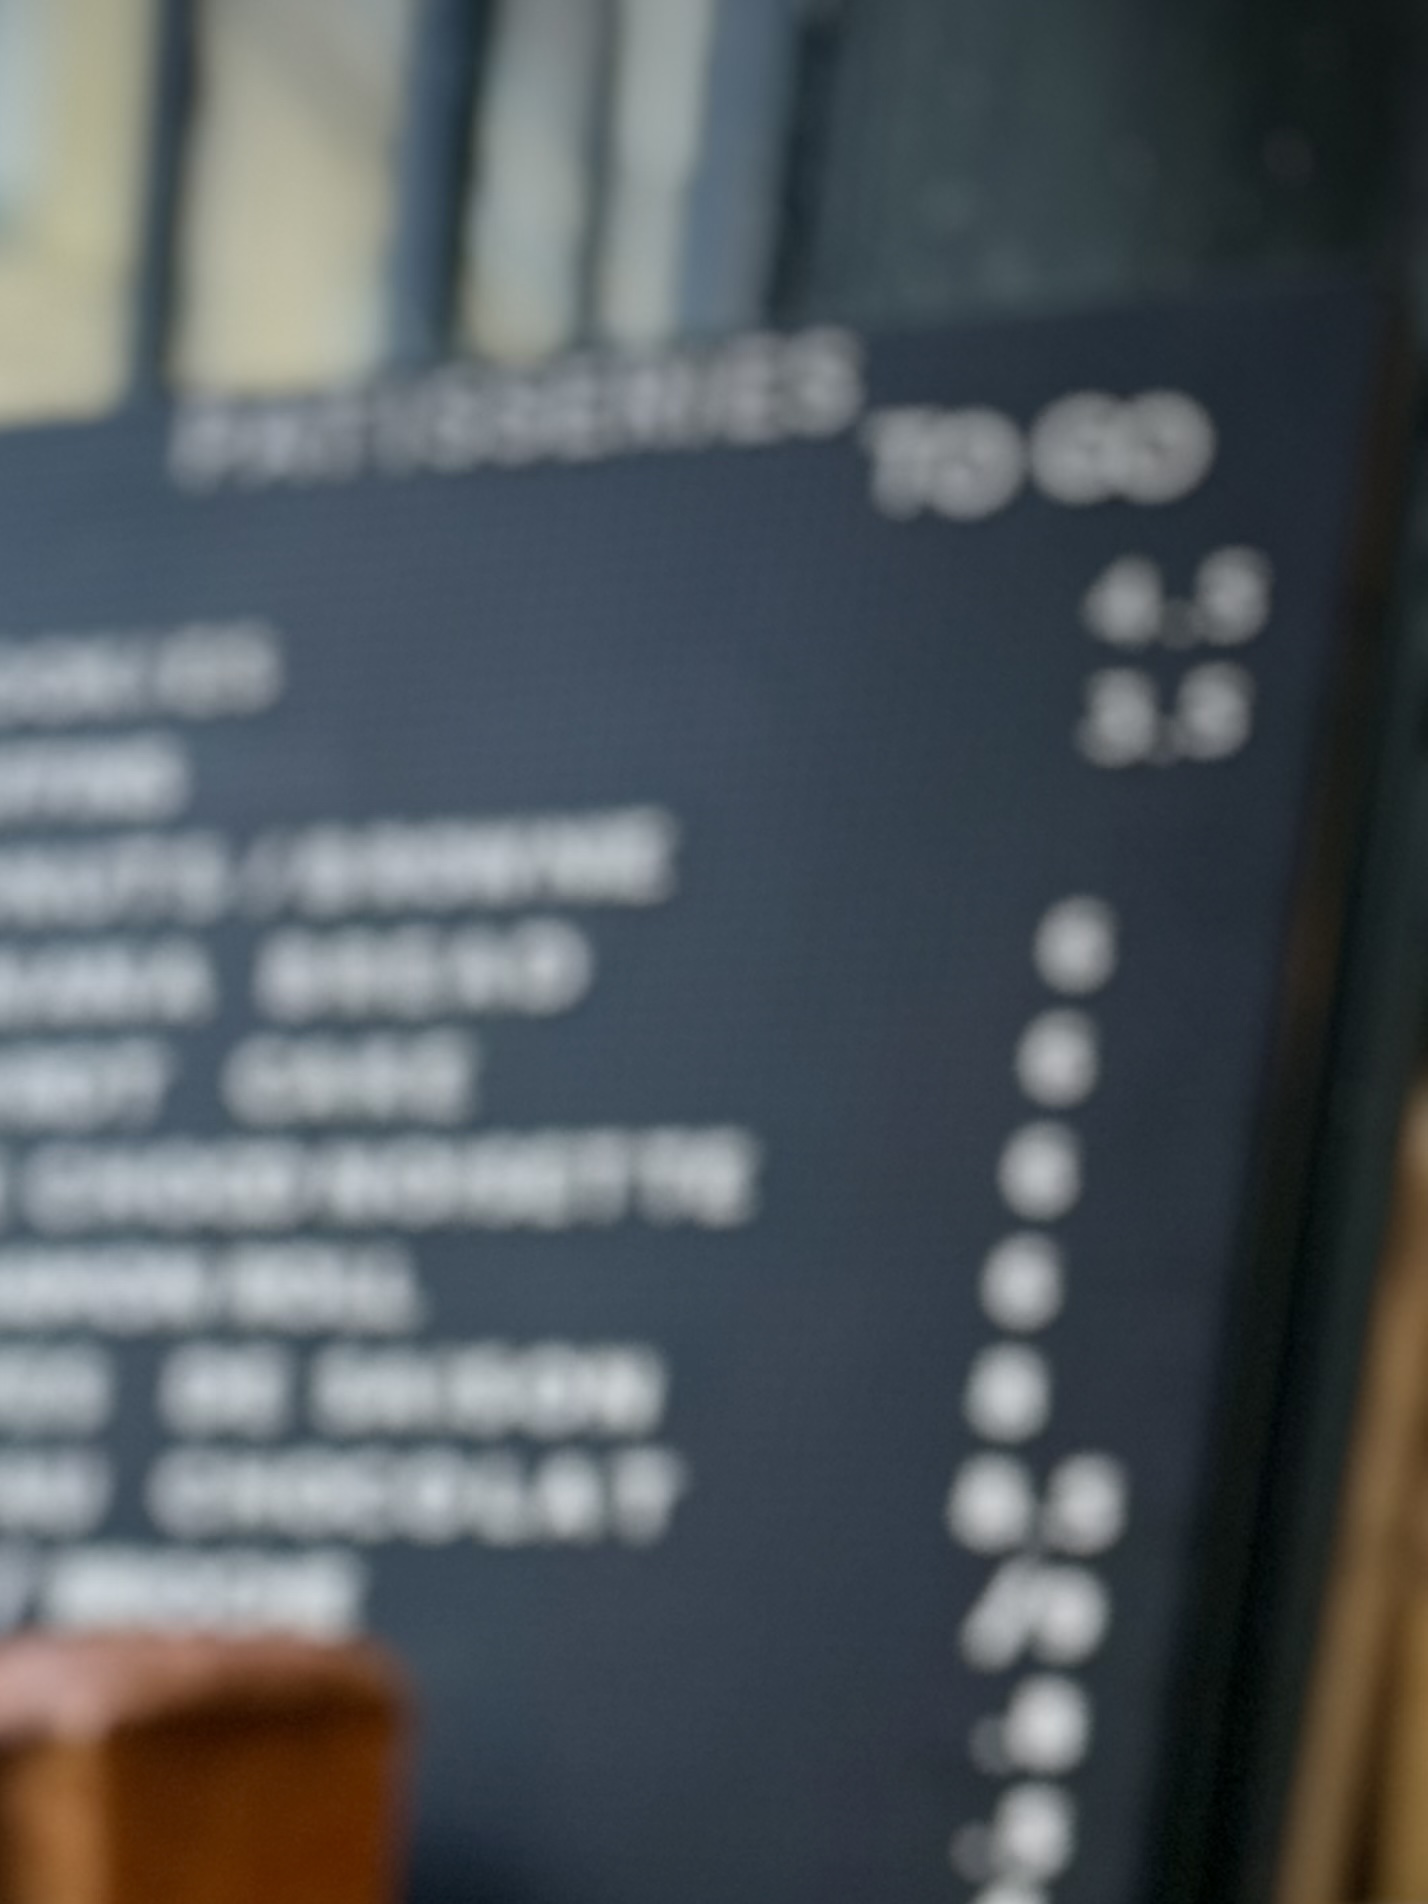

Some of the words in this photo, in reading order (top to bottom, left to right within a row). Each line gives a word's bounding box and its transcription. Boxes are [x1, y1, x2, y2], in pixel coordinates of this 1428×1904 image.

[174, 335, 856, 480] PATISSERIES
[869, 408, 1024, 518] TO
[1034, 393, 1210, 502] GO
[1089, 552, 1266, 648] 4.5
[256, 923, 587, 1022] BREAD
[226, 1033, 472, 1125] CAKE
[309, 1133, 756, 1230] NOISETTE
[224, 1248, 419, 1333] ROLL
[162, 1350, 286, 1435] DE
[314, 1350, 661, 1437] SAISON
[152, 1450, 672, 1545] CHOCOLAT
